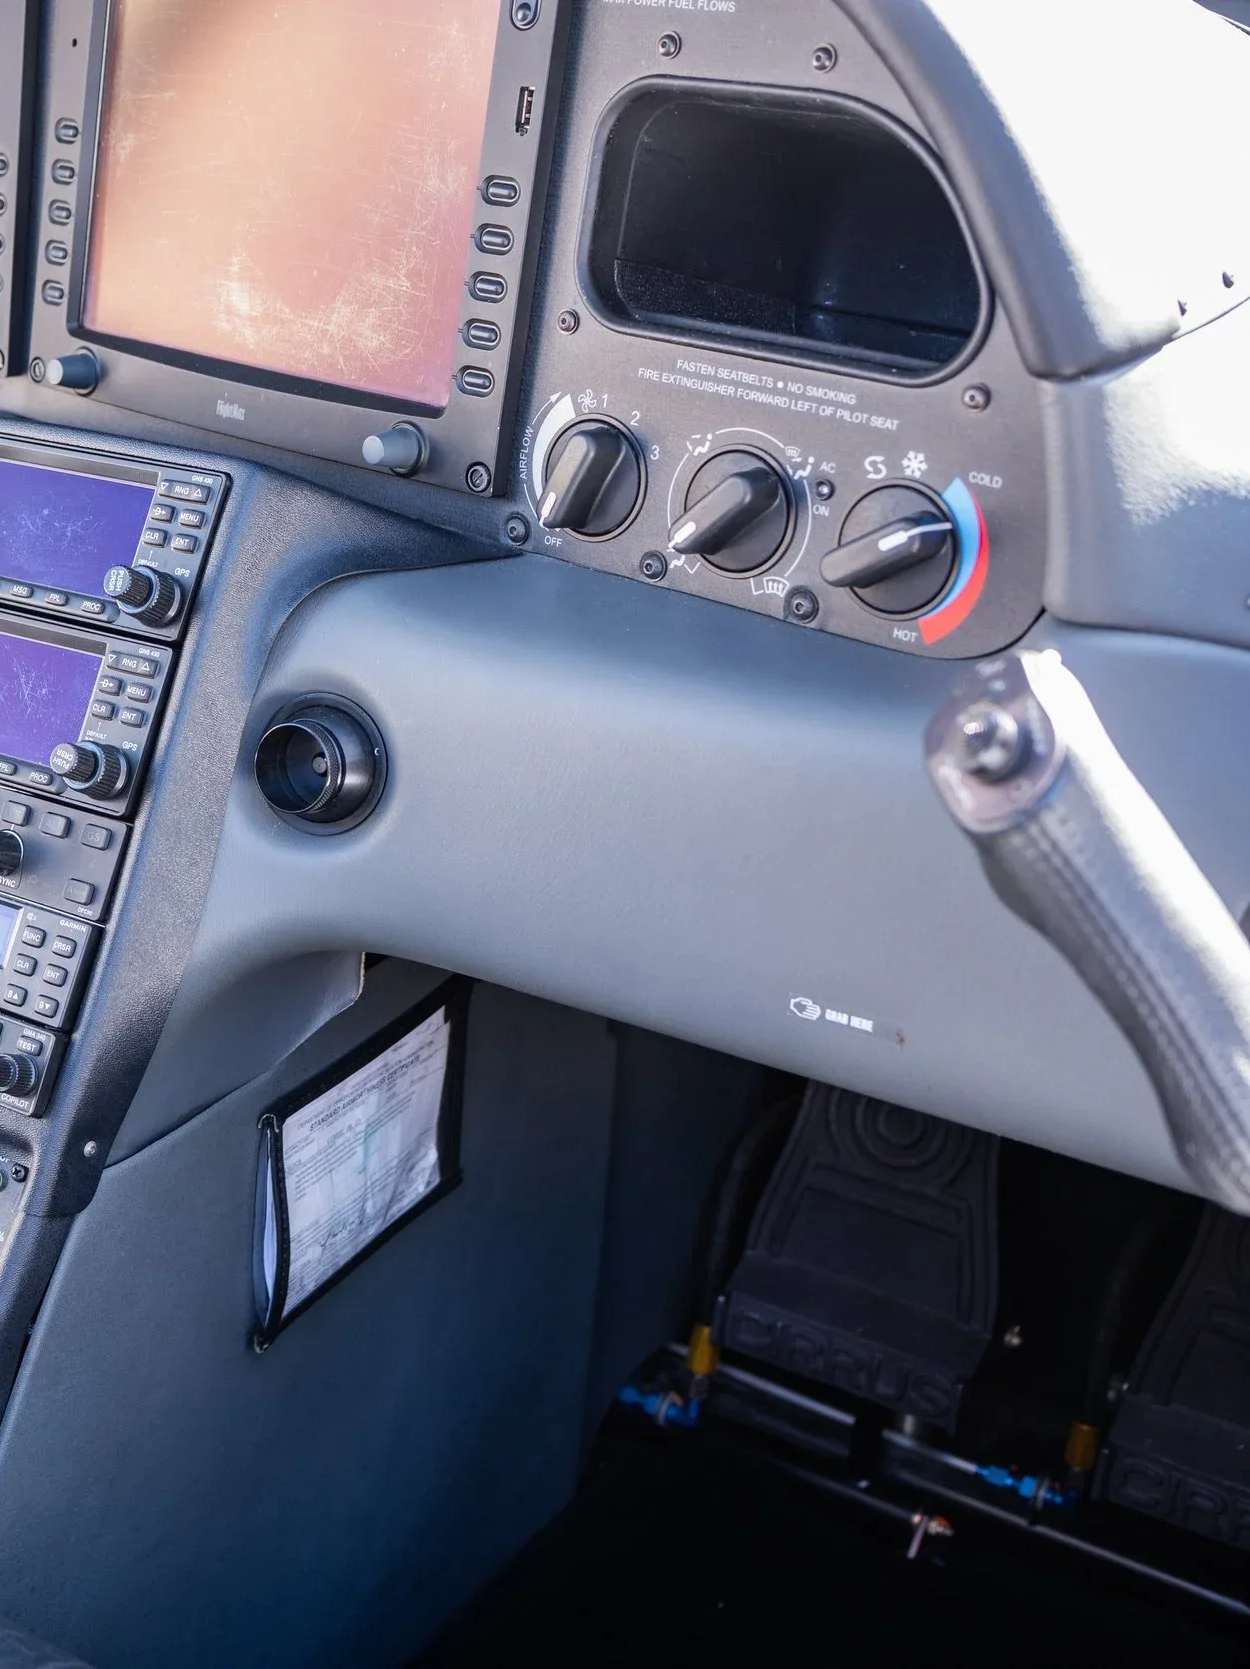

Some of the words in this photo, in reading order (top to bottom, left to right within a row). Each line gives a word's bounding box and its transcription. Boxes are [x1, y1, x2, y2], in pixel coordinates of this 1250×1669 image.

[668, 0, 695, 9] FUEL
[697, 1, 735, 12] FLOWS
[677, 359, 716, 376] FASTEN
[717, 367, 774, 388] SEATBELTS
[787, 381, 804, 394] NO
[805, 385, 856, 406] SMOKING
[601, 393, 608, 409] 1
[638, 368, 659, 381] FIRE
[662, 372, 735, 397] EXTINGUISHER
[737, 388, 789, 408] FORWARD
[791, 400, 817, 414] LEFT
[819, 405, 835, 417] OF
[836, 409, 869, 424] PILOT
[870, 416, 899, 431] SEAT
[630, 410, 640, 426] 2
[519, 426, 534, 480] AIRFLOW
[650, 445, 660, 460] 3
[819, 461, 837, 473] AC
[191, 475, 204, 483] GNS
[204, 477, 214, 485] 430
[968, 471, 1002, 488] COLD
[174, 485, 190, 495] RNG
[813, 504, 830, 516] ON
[180, 512, 200, 522] MENU
[145, 531, 159, 540] CLR
[174, 537, 190, 546] ENT
[544, 536, 562, 547] OFF
[174, 568, 191, 578] GPS
[108, 569, 117, 591] CRSR
[115, 569, 125, 591] PUSH
[12, 584, 28, 594] MSG
[49, 593, 61, 602] FPL
[82, 600, 100, 611] PROC
[892, 628, 919, 642] HOT
[138, 647, 151, 656] GNS
[150, 650, 161, 658] 430
[121, 658, 137, 668] RNG
[127, 686, 147, 697] MENU
[92, 703, 107, 712] CLR
[122, 711, 137, 721] ENT
[86, 730, 108, 740] DEFAULT
[122, 741, 138, 752] GPS
[56, 747, 73, 761] CRSR
[52, 756, 71, 769] PUSH
[29, 772, 48, 783] PROC
[87, 832, 100, 842] GS
[60, 919, 87, 932] GARMIN
[22, 930, 41, 942] FUNC
[53, 940, 71, 952] CRSR
[16, 959, 30, 970] CLR
[46, 970, 59, 981] ENT
[23, 1028, 35, 1037] GMA
[35, 1032, 46, 1041] 340
[19, 1040, 36, 1052] TEST
[1, 1093, 29, 1109] COPILOT
[734, 1308, 954, 1420] CIRRUS
